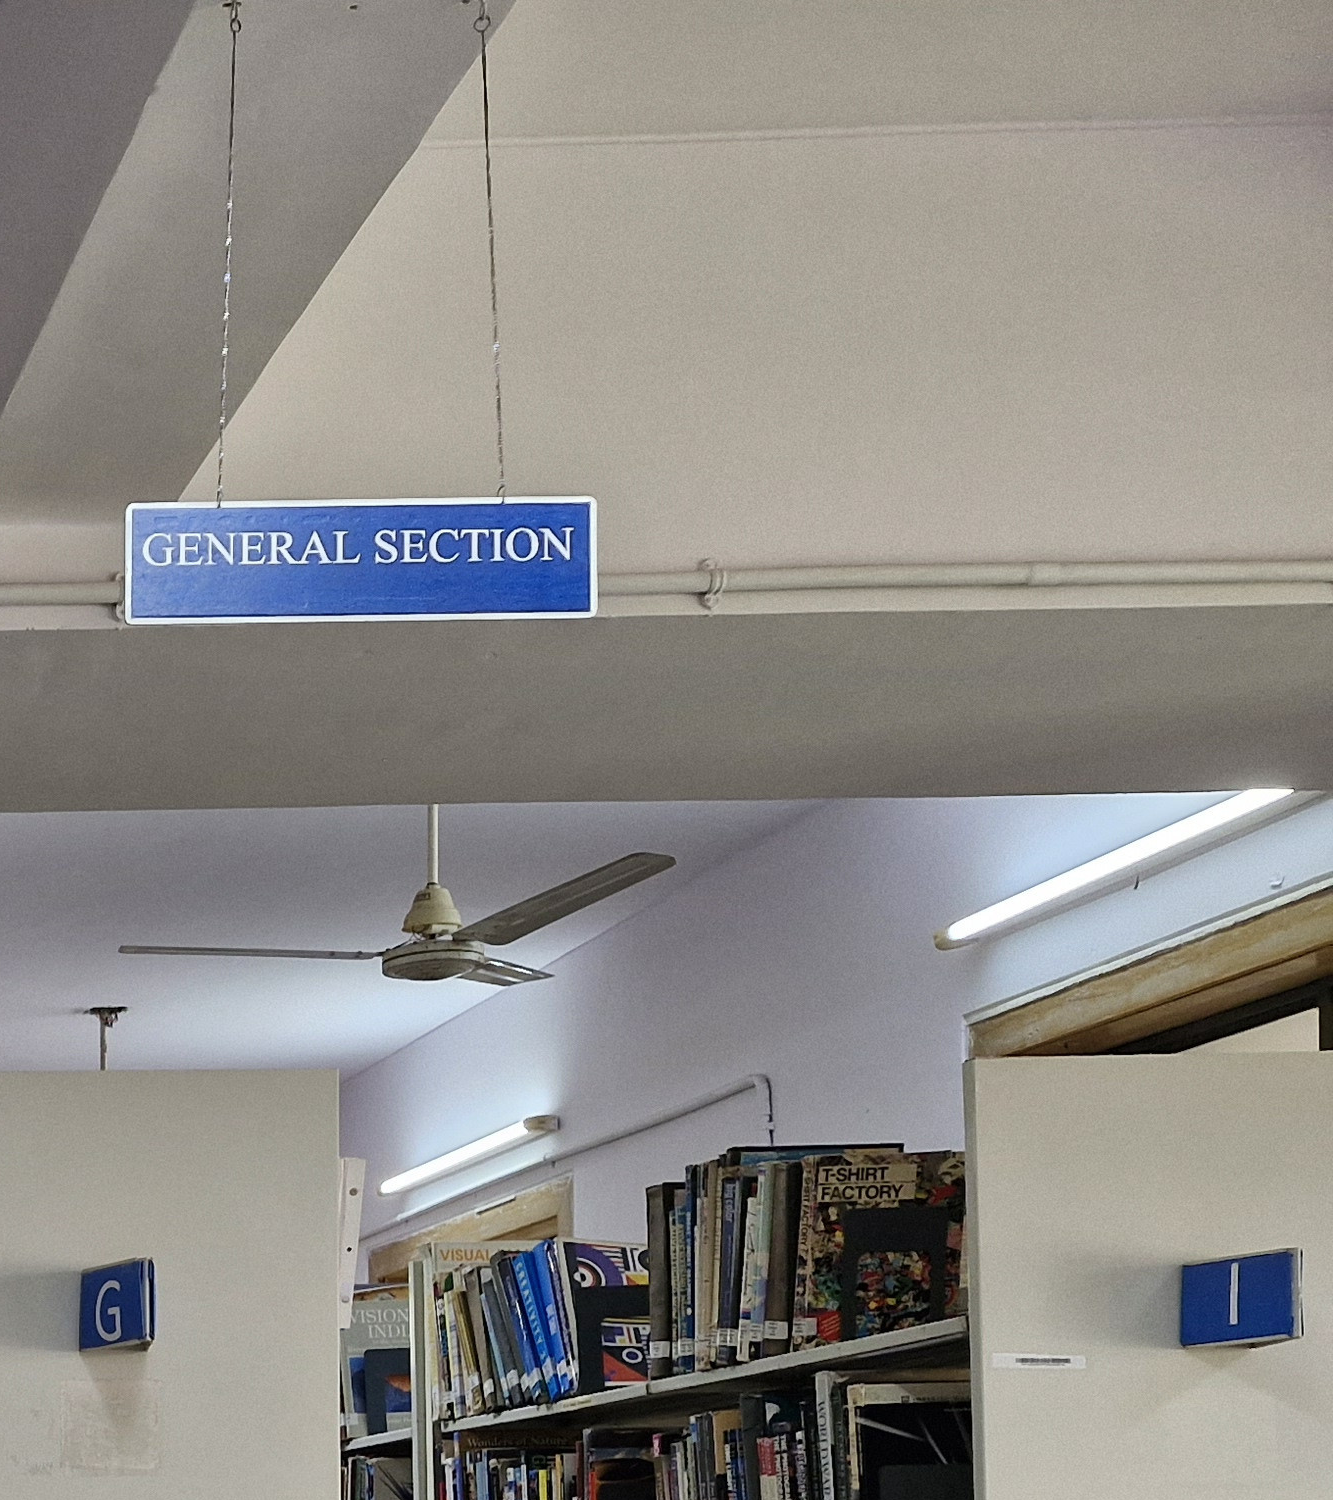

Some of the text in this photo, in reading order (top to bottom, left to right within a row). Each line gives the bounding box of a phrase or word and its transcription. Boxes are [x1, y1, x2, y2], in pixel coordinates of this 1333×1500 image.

[141, 527, 574, 567] GENERAL SECTION
[822, 1166, 889, 1182] T-SHIRT
[820, 1184, 904, 1200] FACTORY
[1228, 1262, 1239, 1326] I
[95, 1279, 122, 1342] G
[368, 1324, 408, 1338] INDI
